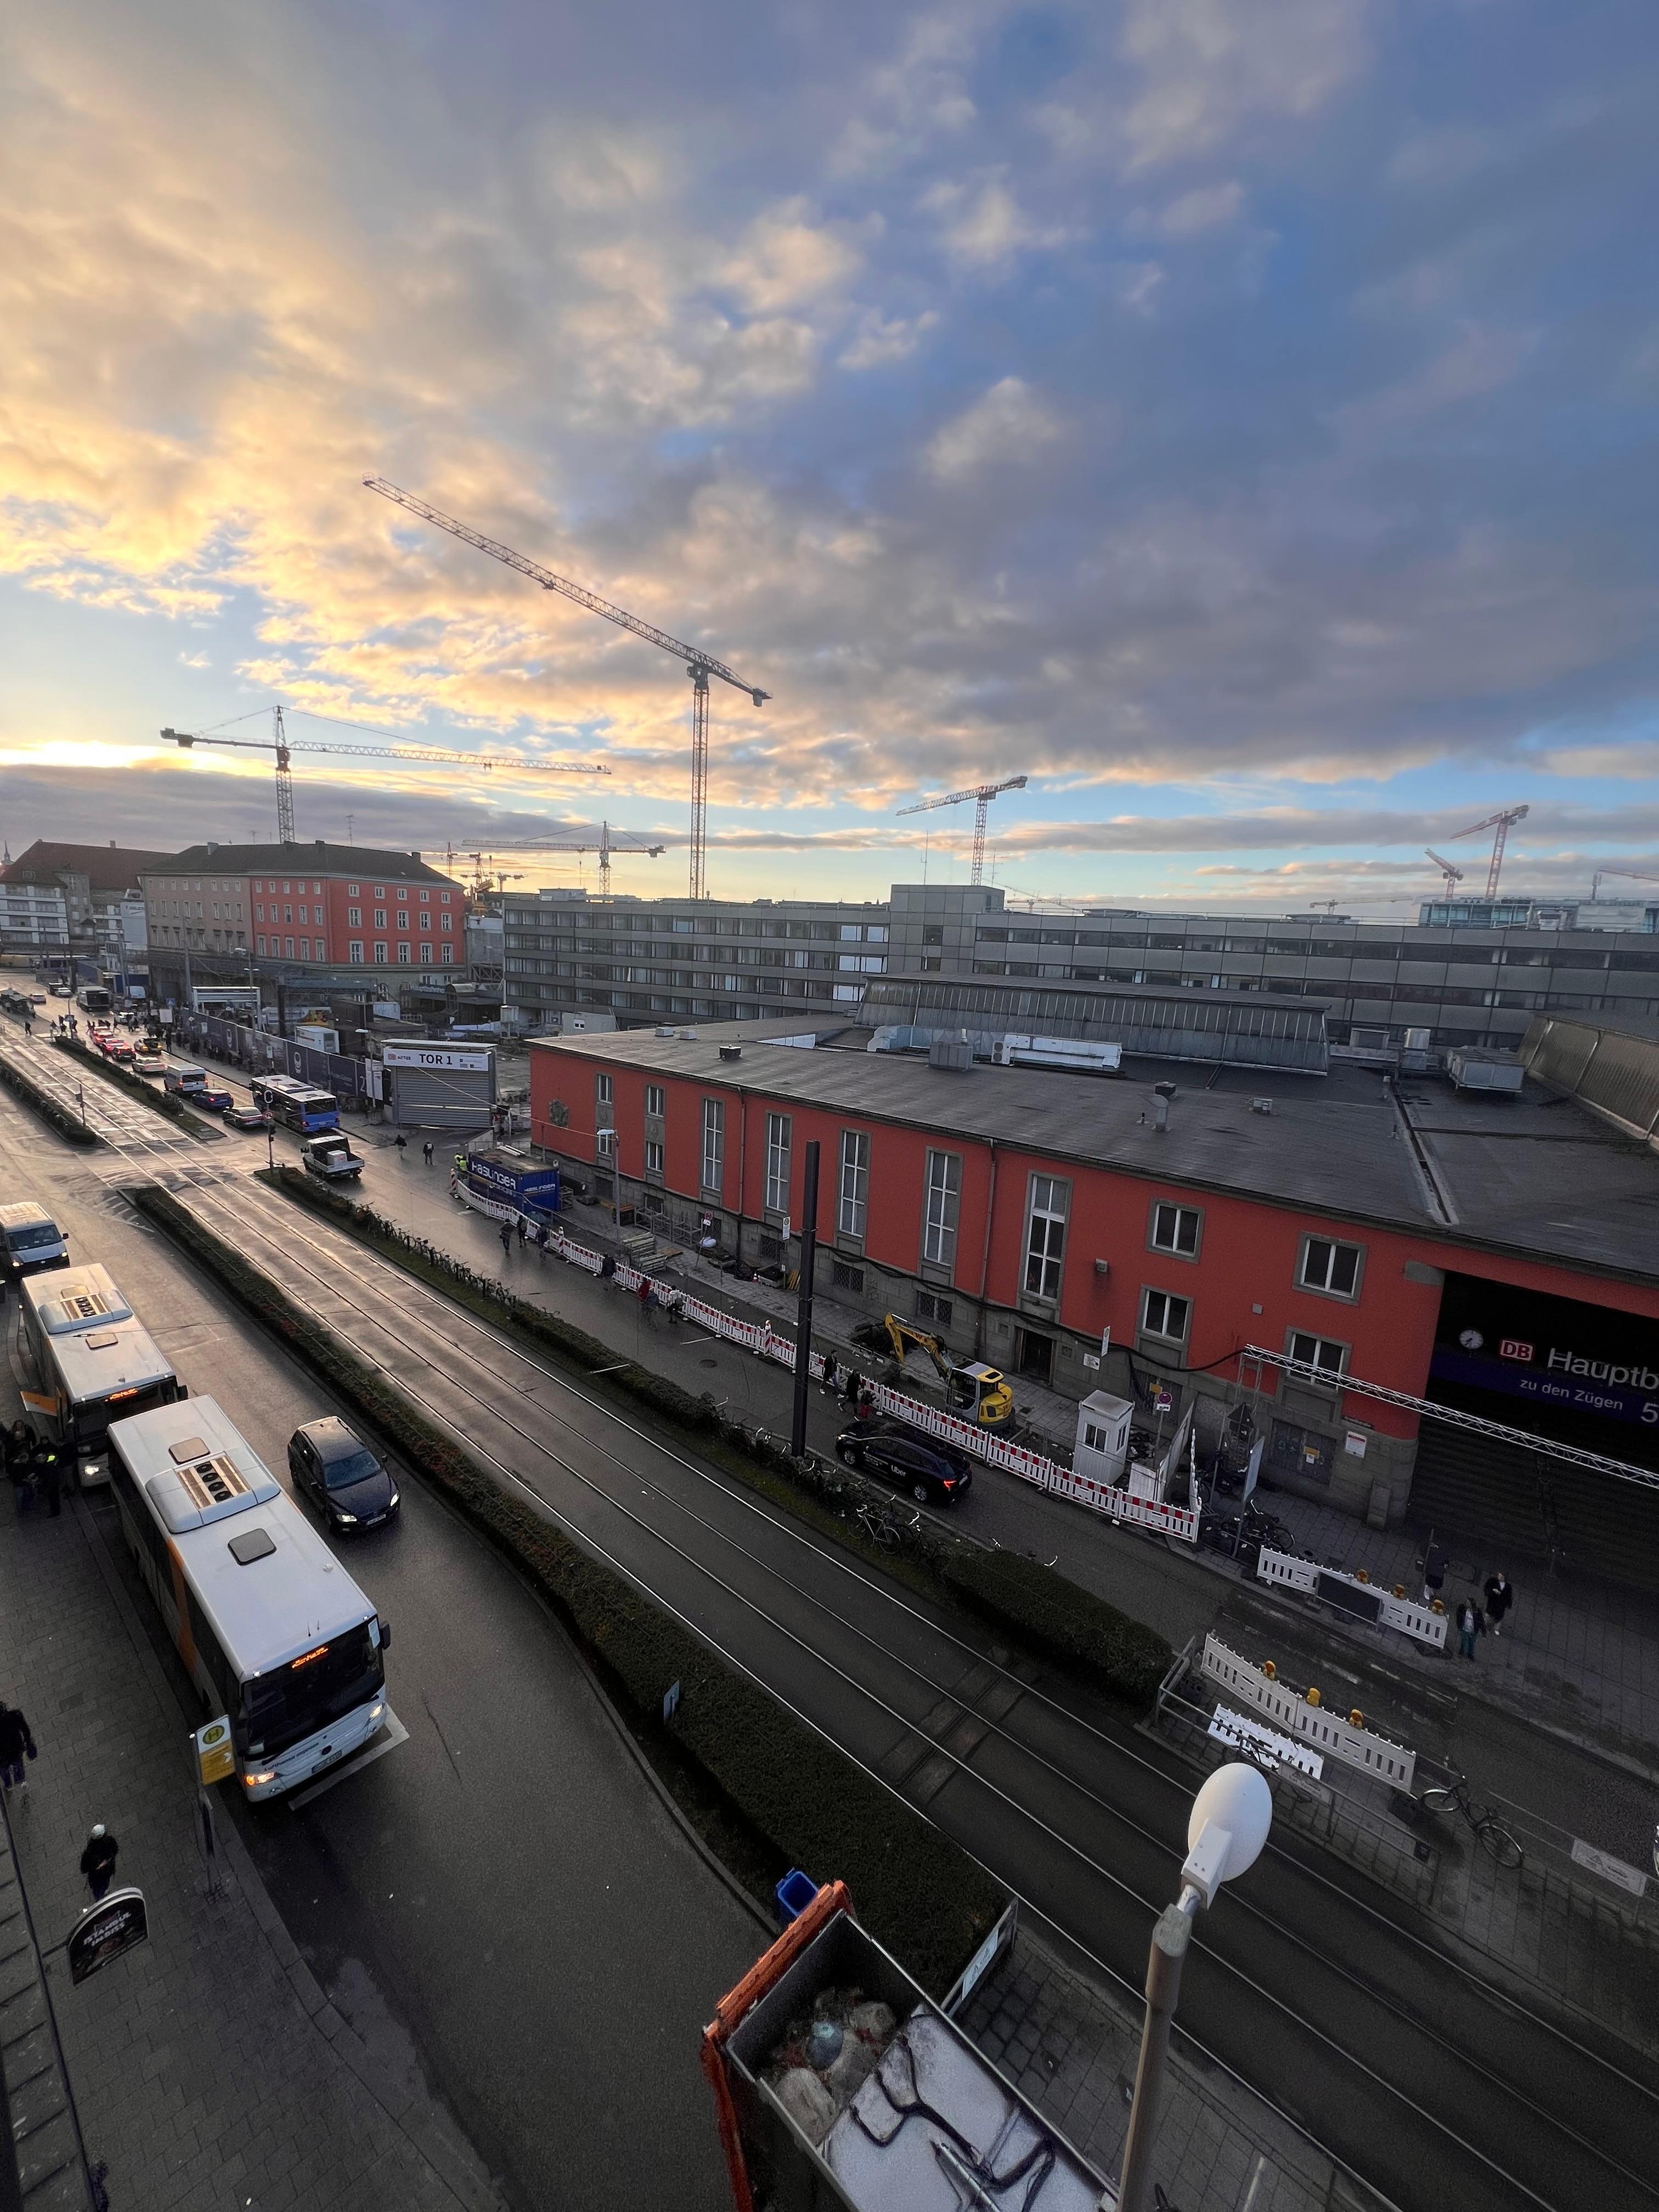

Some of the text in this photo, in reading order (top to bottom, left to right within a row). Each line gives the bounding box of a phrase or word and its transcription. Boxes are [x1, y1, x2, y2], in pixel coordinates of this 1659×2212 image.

[419, 1053, 443, 1065] TOR
[447, 1056, 453, 1065] 1
[1503, 1341, 1659, 1390] DB Hauptb
[1519, 1379, 1624, 1410] zu den Zügen
[891, 1464, 906, 1477] Uber
[207, 1729, 219, 1741] H
[83, 1911, 132, 1946] ISTANBUL
